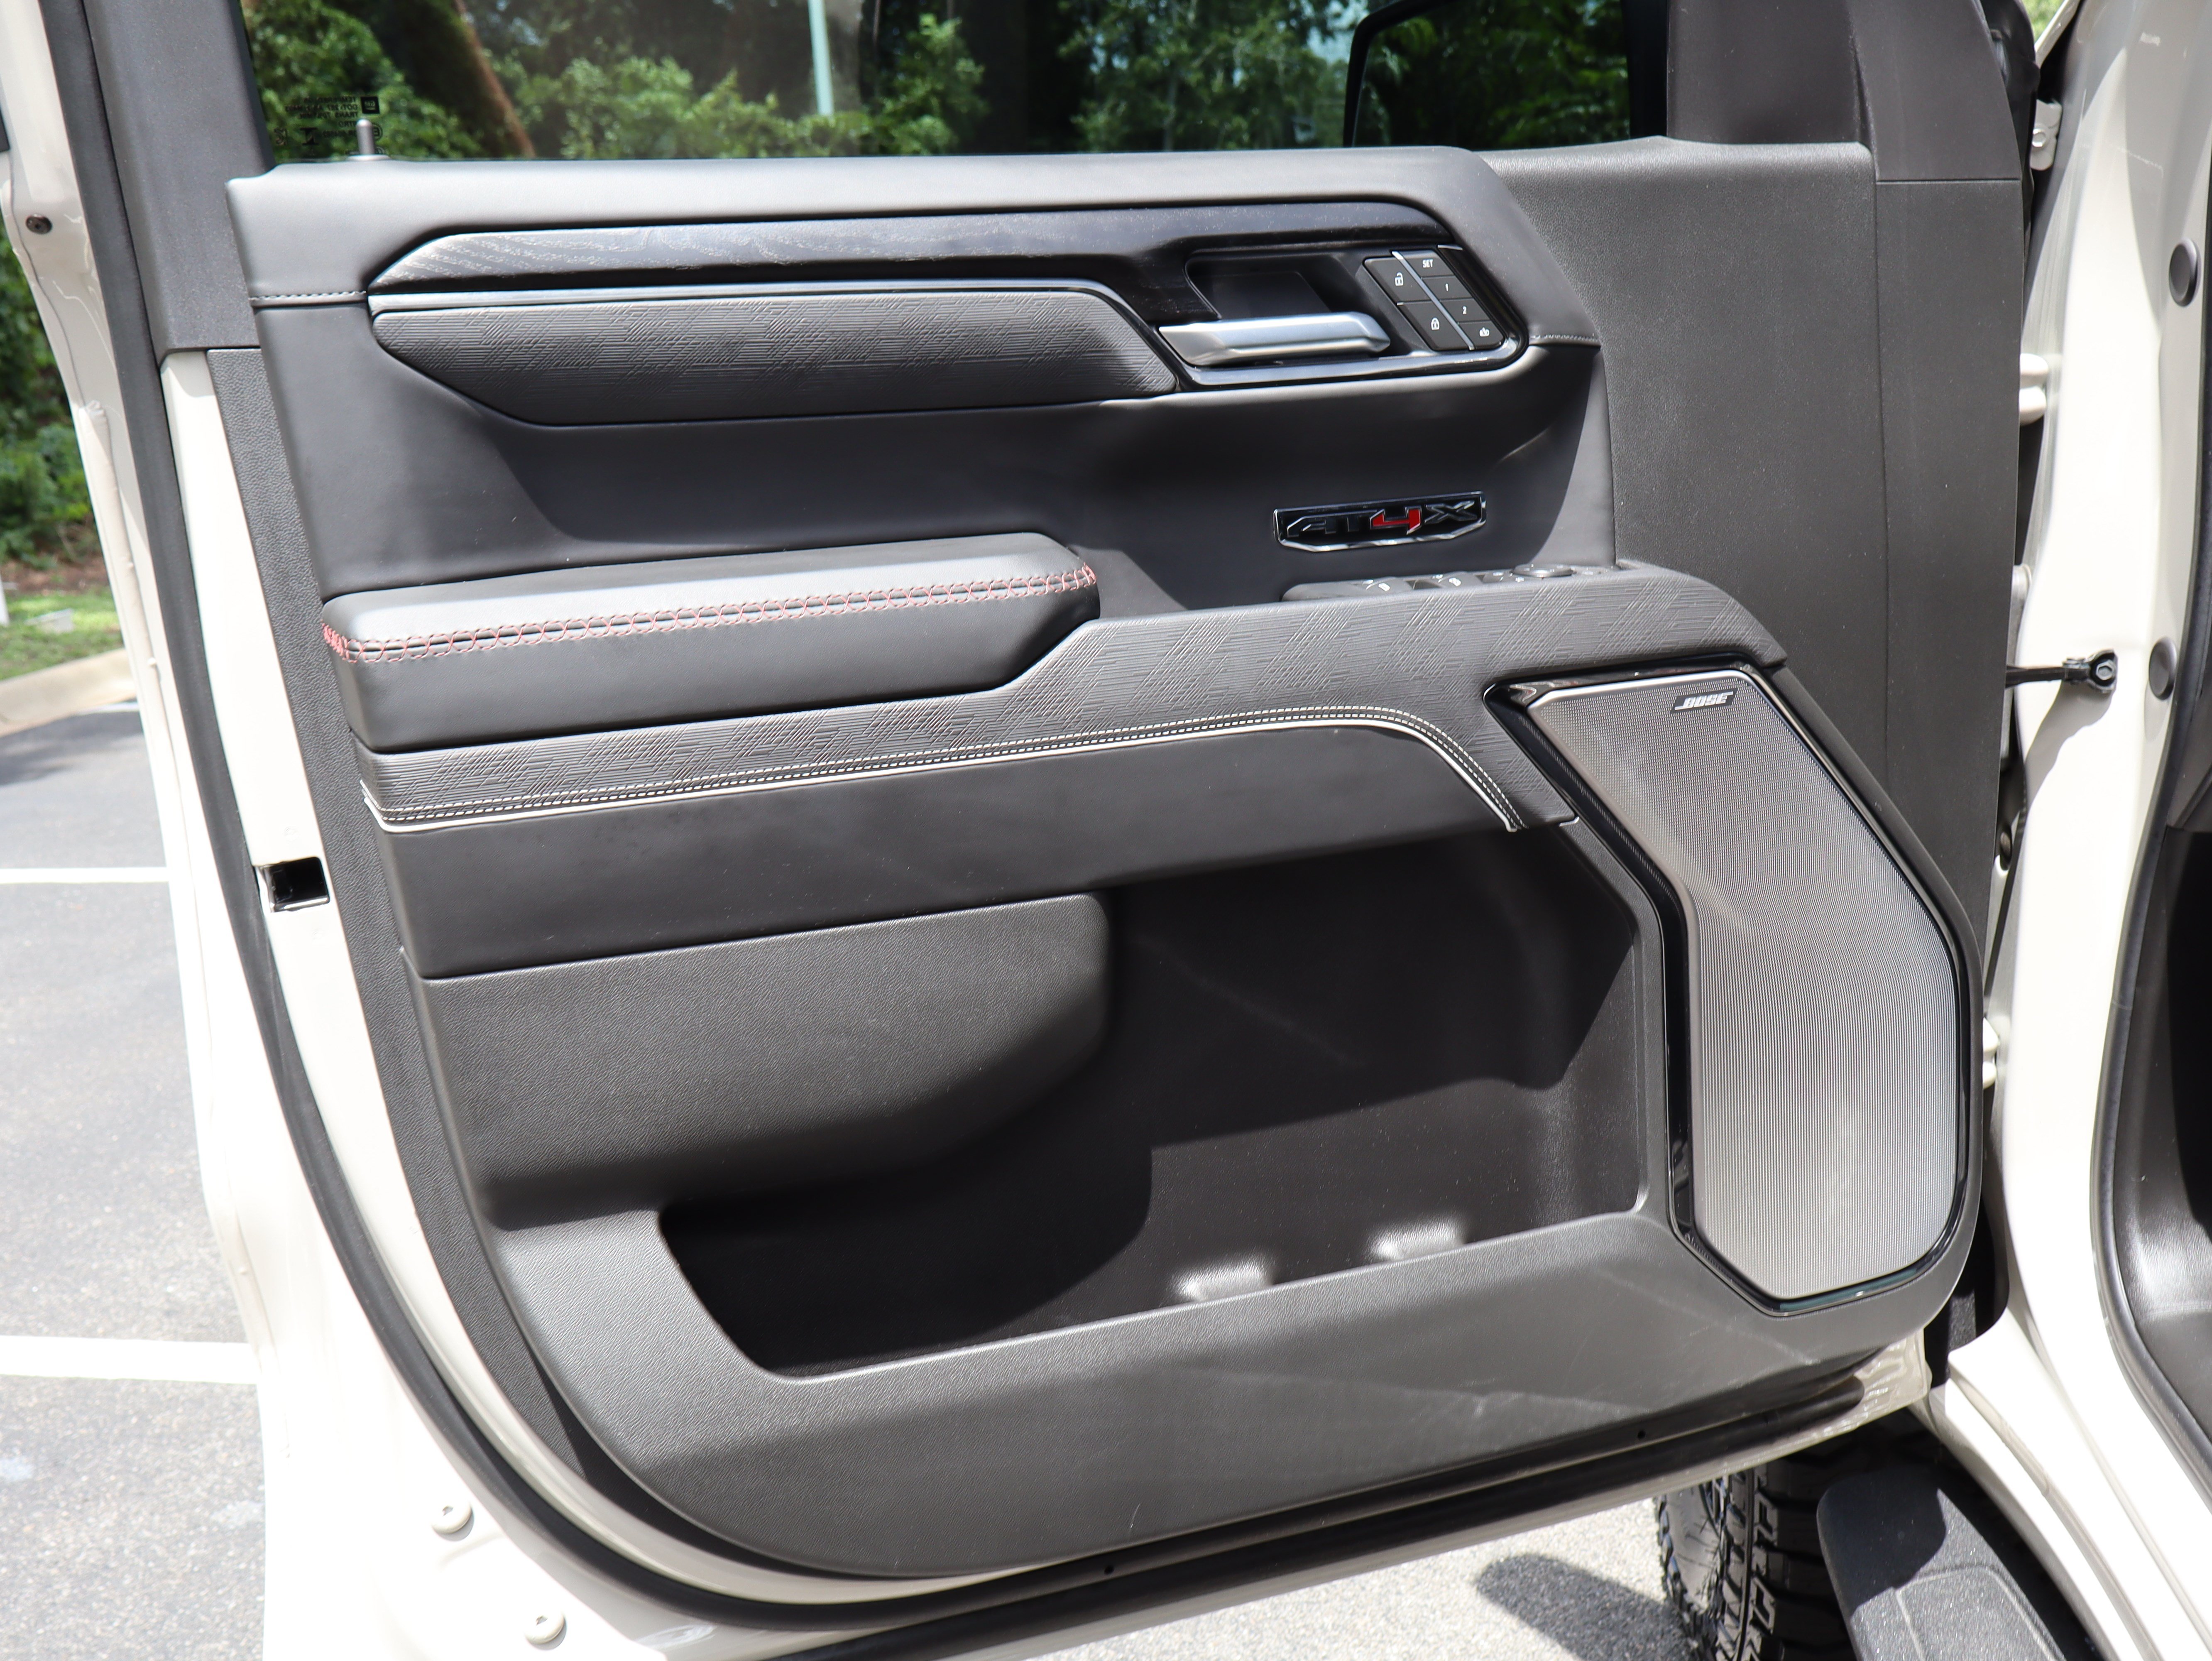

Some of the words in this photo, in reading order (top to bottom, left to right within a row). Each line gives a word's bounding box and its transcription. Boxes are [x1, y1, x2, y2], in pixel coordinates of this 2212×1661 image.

[1422, 259, 1434, 268] SET
[1462, 306, 1467, 314] 2
[1287, 500, 1478, 538] AT4X
[1674, 691, 1734, 710] BOSE
